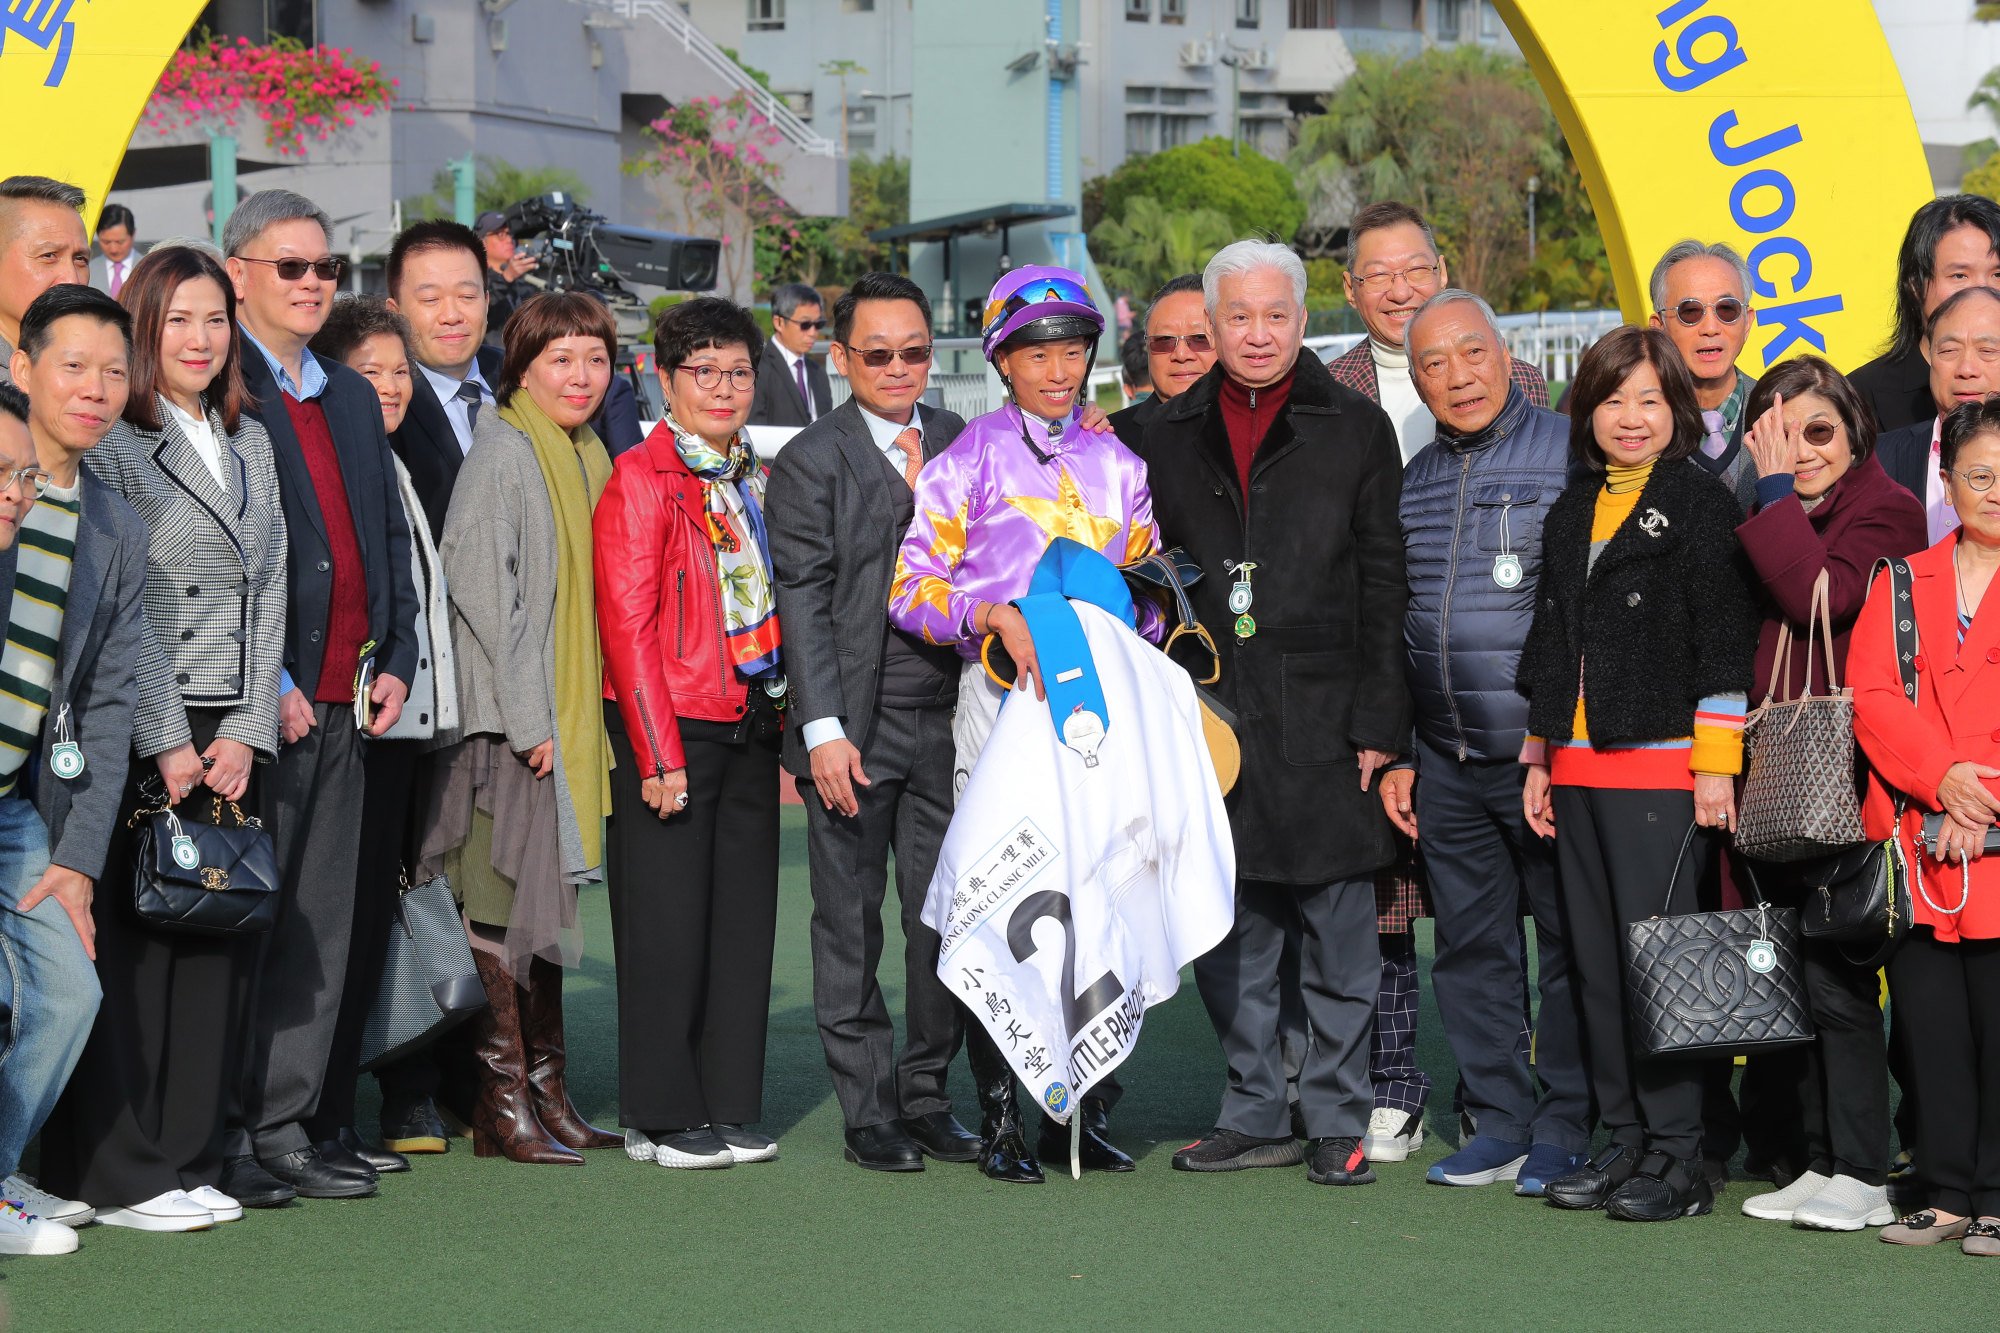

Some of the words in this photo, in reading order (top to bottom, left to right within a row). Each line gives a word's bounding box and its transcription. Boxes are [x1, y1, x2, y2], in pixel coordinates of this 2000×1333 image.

[1505, 568, 1511, 578] 8
[1238, 595, 1243, 604] 8
[64, 757, 71, 767] 8
[183, 849, 189, 859] 8
[940, 925, 964, 955] HONG
[960, 900, 989, 929] KONG
[986, 867, 1025, 904] CLASSIC
[1022, 846, 1048, 872] MILE
[1758, 953, 1764, 963] 8
[1006, 889, 1125, 1044] 2
[961, 967, 1053, 1079] 小鳥天堂
[1066, 1025, 1118, 1092] LITTLE
